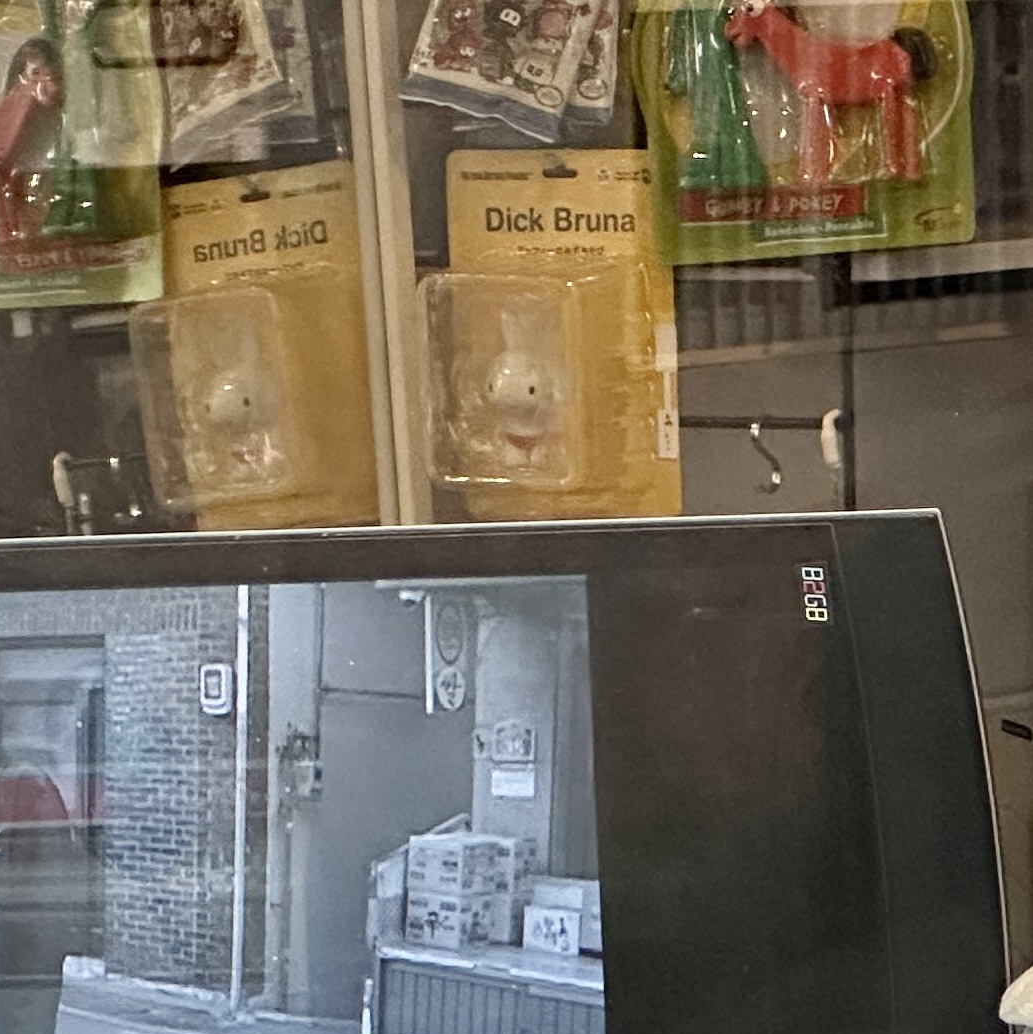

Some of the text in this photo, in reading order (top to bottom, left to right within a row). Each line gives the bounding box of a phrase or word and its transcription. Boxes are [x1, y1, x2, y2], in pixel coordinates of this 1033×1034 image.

[788, 193, 843, 211] POKEY
[485, 207, 635, 232] Dick Bruna
